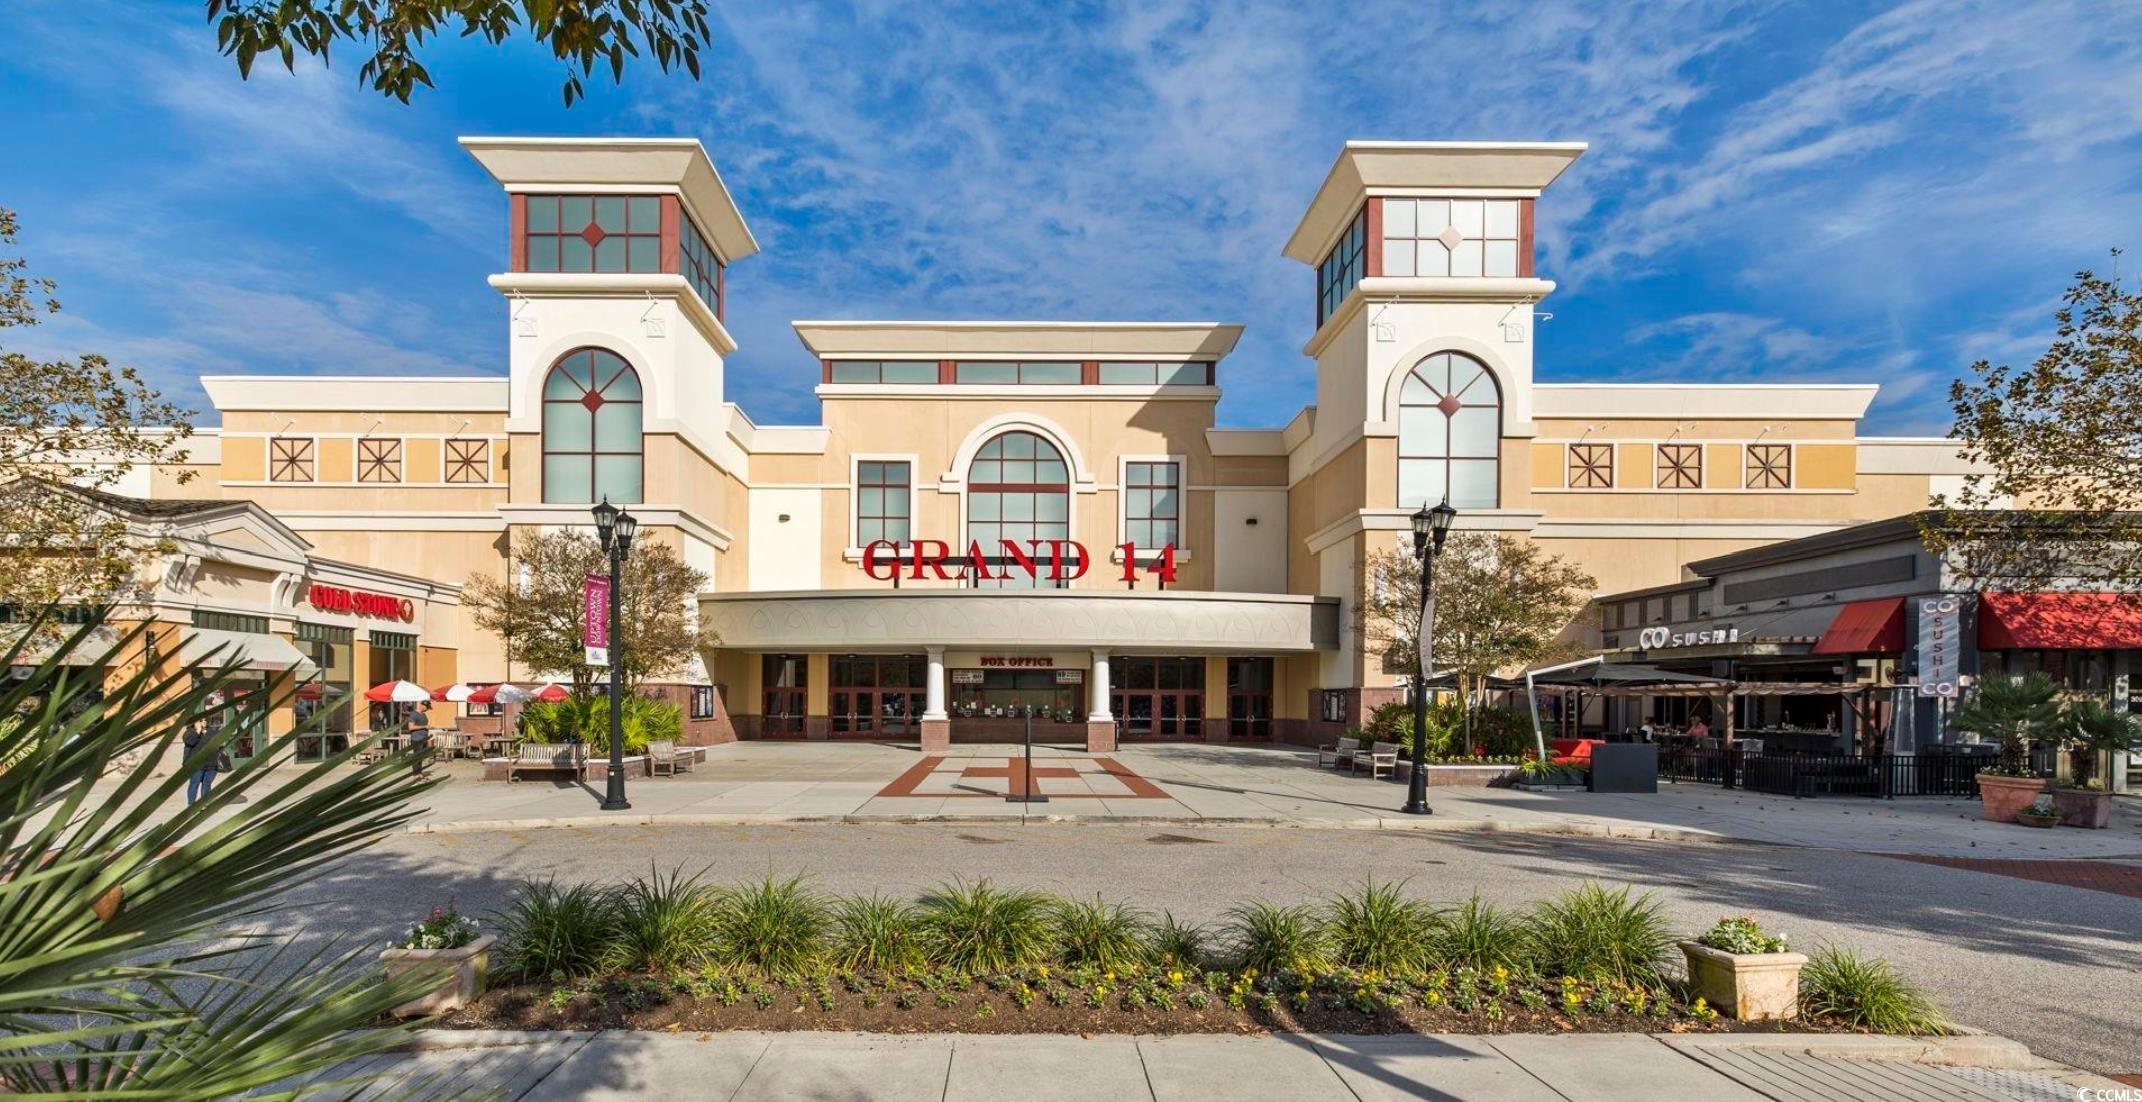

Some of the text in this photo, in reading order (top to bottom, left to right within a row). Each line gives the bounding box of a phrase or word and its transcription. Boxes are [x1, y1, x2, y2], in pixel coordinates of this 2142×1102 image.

[862, 539, 1177, 583] GRAND 14
[589, 588, 597, 644] UPTOWN
[1923, 600, 1955, 614] CO
[1640, 626, 1671, 650] CO
[1932, 617, 1943, 679] SUSHI
[980, 656, 1053, 667] BOX OFFICE
[1922, 682, 1954, 696] CO
